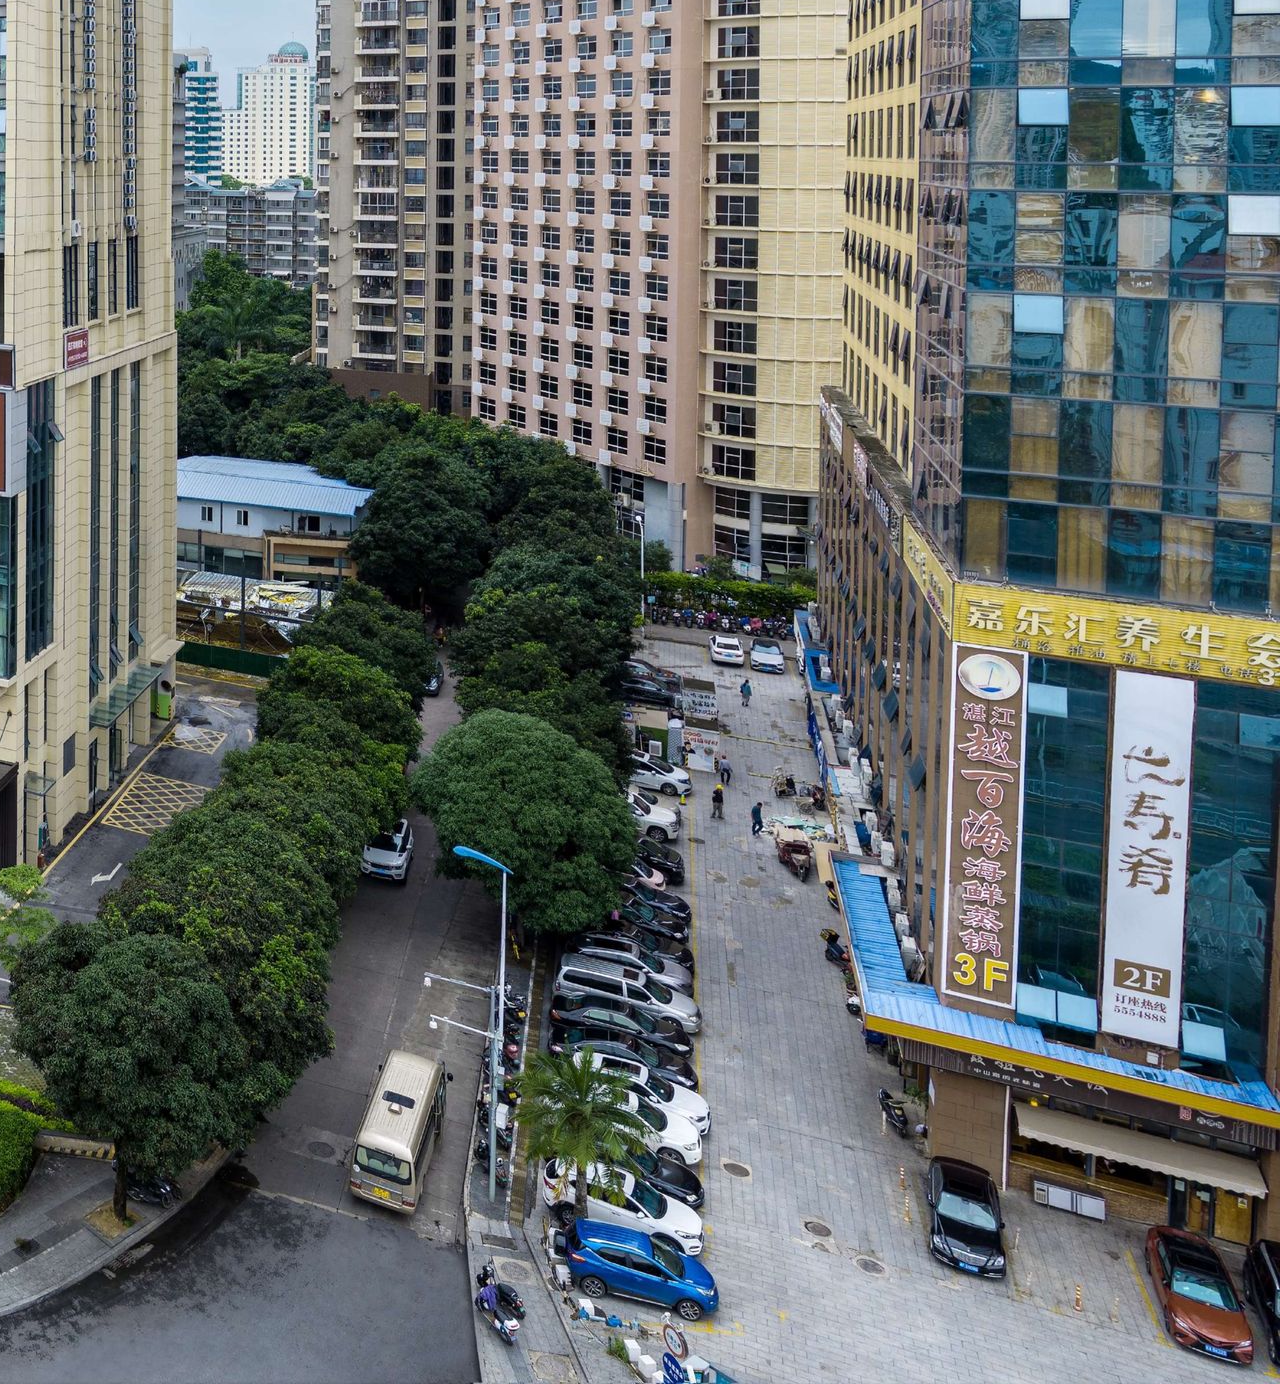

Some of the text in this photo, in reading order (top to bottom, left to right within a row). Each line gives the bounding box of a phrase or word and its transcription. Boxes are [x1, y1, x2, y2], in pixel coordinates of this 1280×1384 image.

[967, 597, 1280, 667] 嘉乐汇养生会
[962, 702, 1015, 727] 湛江
[959, 857, 1007, 957] 海鲜蒸锅
[953, 952, 1009, 991] 3F
[1122, 967, 1163, 992] 2F
[1114, 1005, 1166, 1023] 5554888
[1115, 993, 1167, 1014] 订座热线
